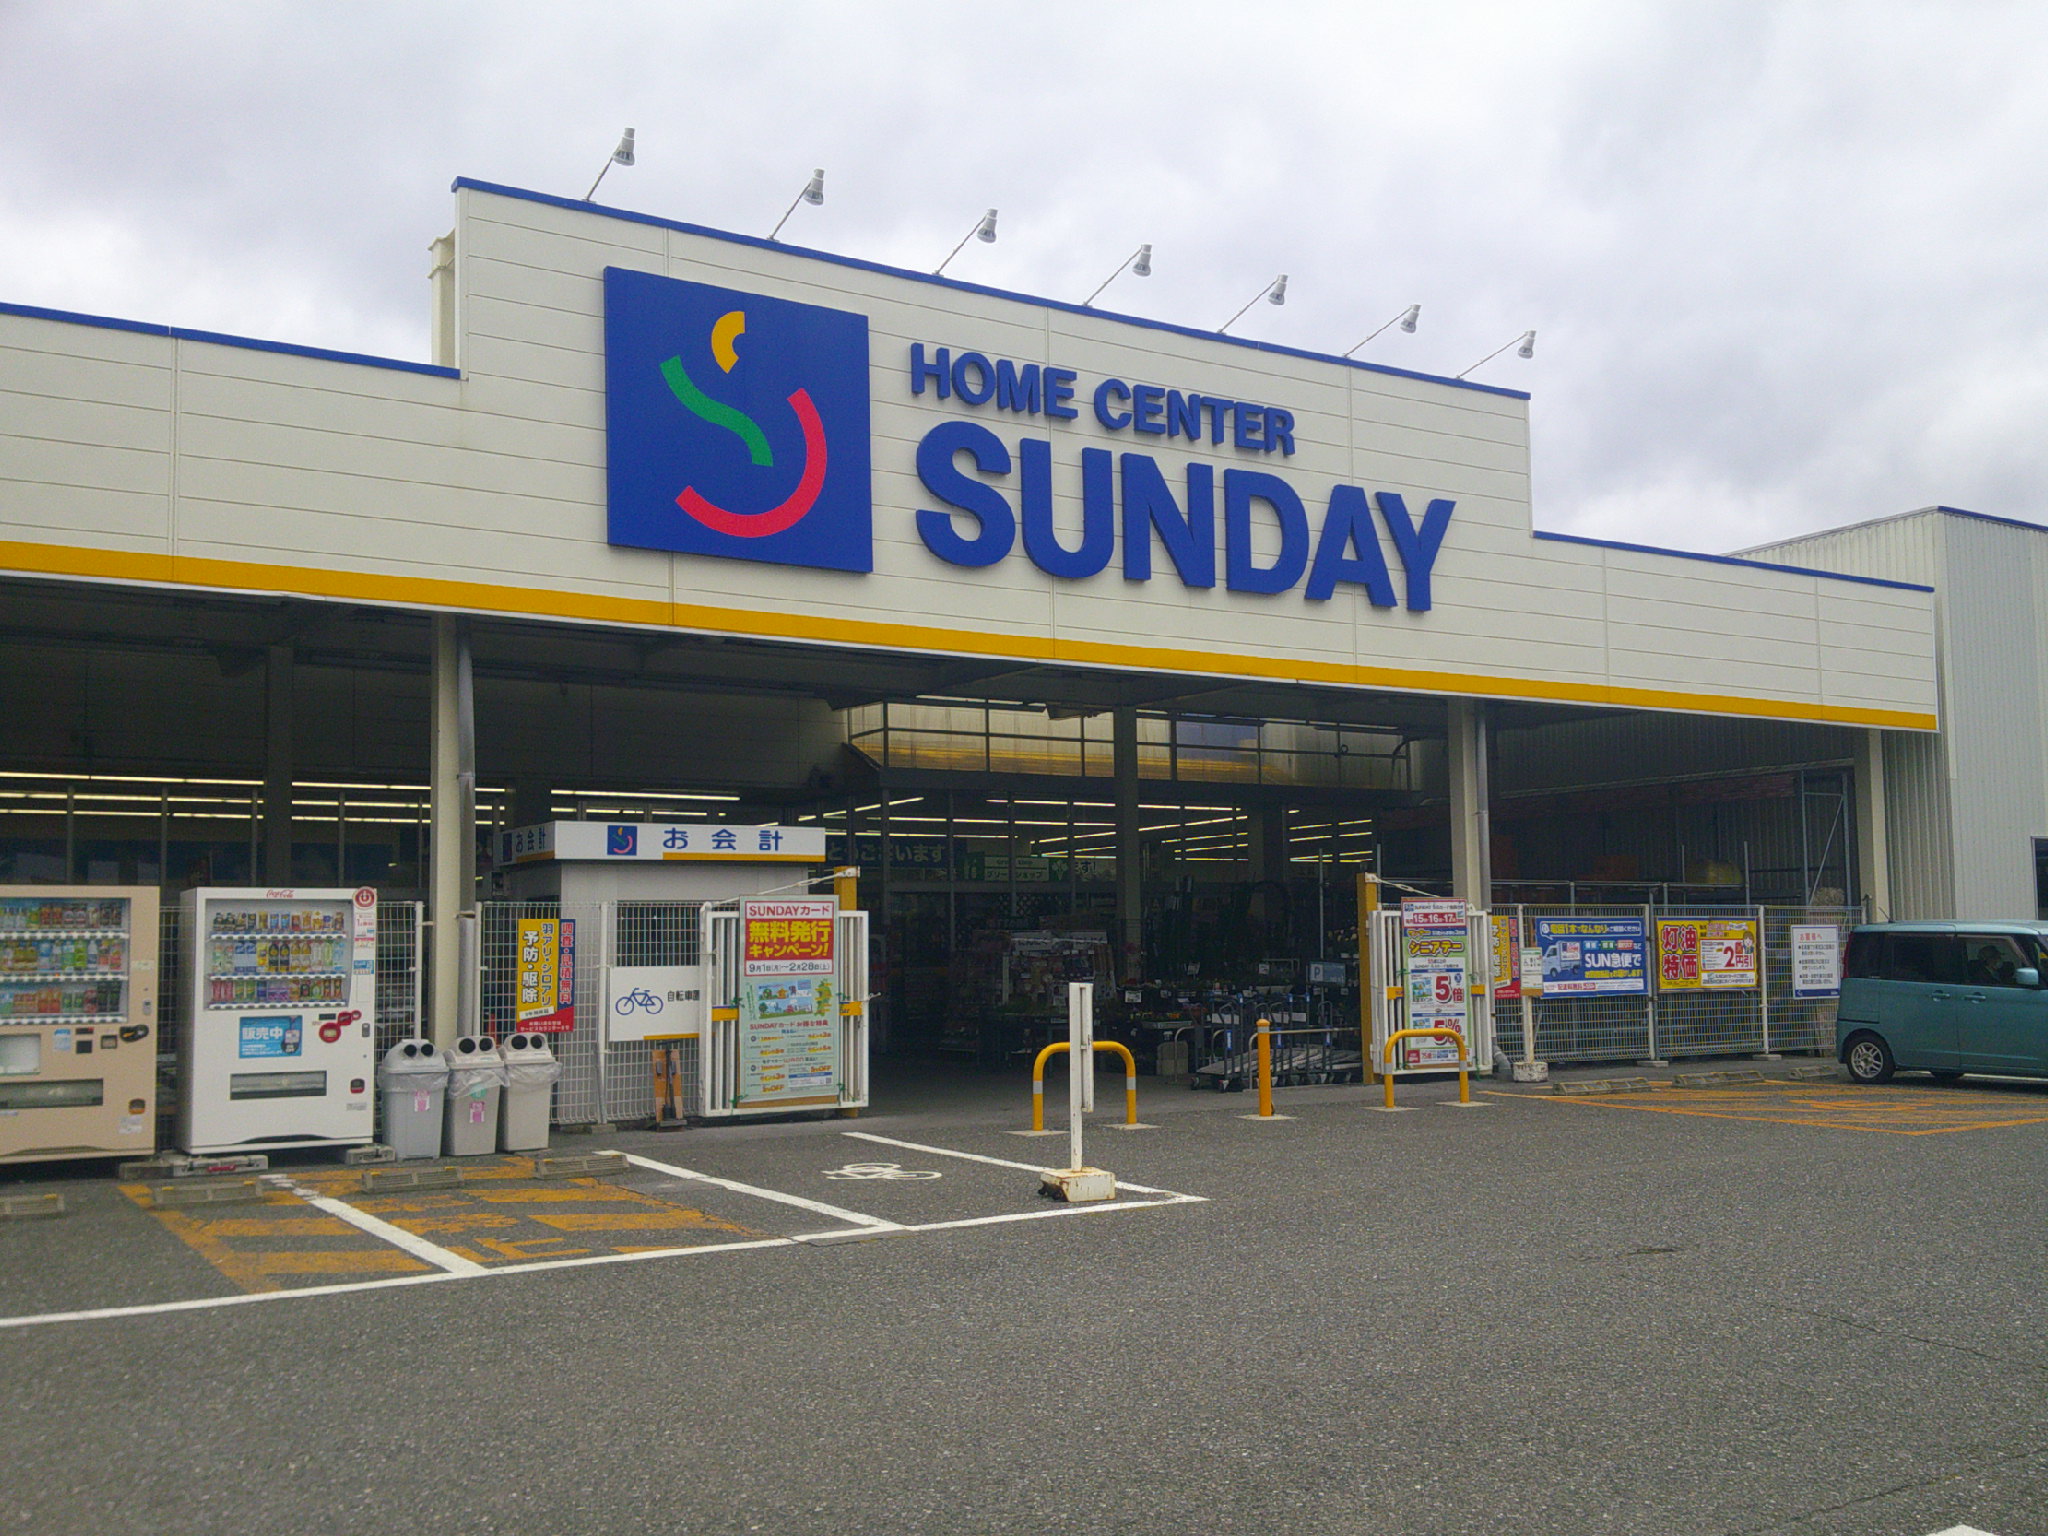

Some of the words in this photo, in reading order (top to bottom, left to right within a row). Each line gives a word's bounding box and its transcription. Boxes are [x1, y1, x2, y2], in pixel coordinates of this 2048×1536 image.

[910, 342, 1078, 419] HOME
[1094, 378, 1296, 456] CENTER
[916, 421, 1457, 612] SUNDAY
[515, 827, 546, 853] お会計
[663, 827, 784, 851] お会計
[749, 905, 830, 917] SUNDAYカード
[749, 920, 832, 943] 無料発行
[1662, 925, 1698, 952] 灯油
[522, 930, 540, 1003] 予防・駆除
[541, 922, 554, 1006] 羽アリ・シロアリ
[1584, 952, 1642, 968] SUN急便で
[1662, 953, 1698, 980] 特価
[242, 1027, 283, 1040] 販売中
